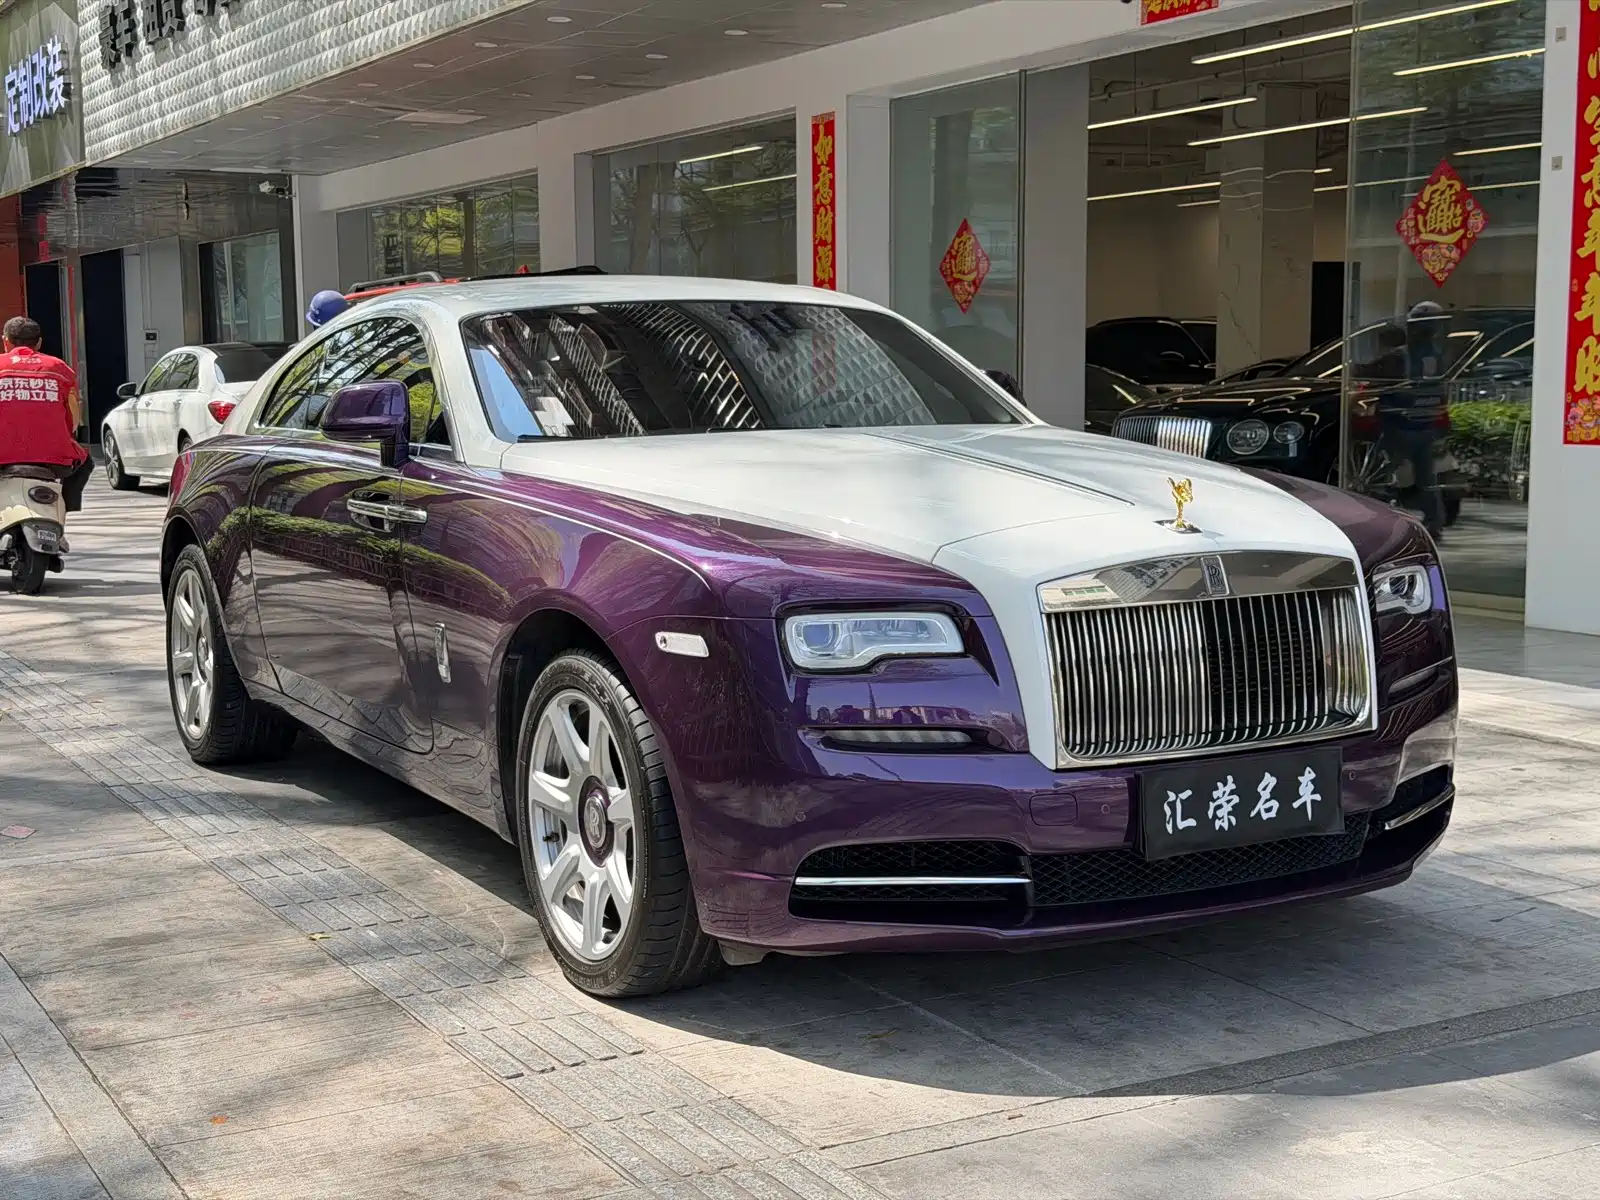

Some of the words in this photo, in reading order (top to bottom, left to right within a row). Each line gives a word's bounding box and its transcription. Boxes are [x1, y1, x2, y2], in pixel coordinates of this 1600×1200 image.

[5, 35, 68, 136] 定制改装
[814, 118, 834, 289] 如意財源
[0, 377, 59, 390] 京东秒送
[1163, 766, 1322, 835] 汇荣名车
